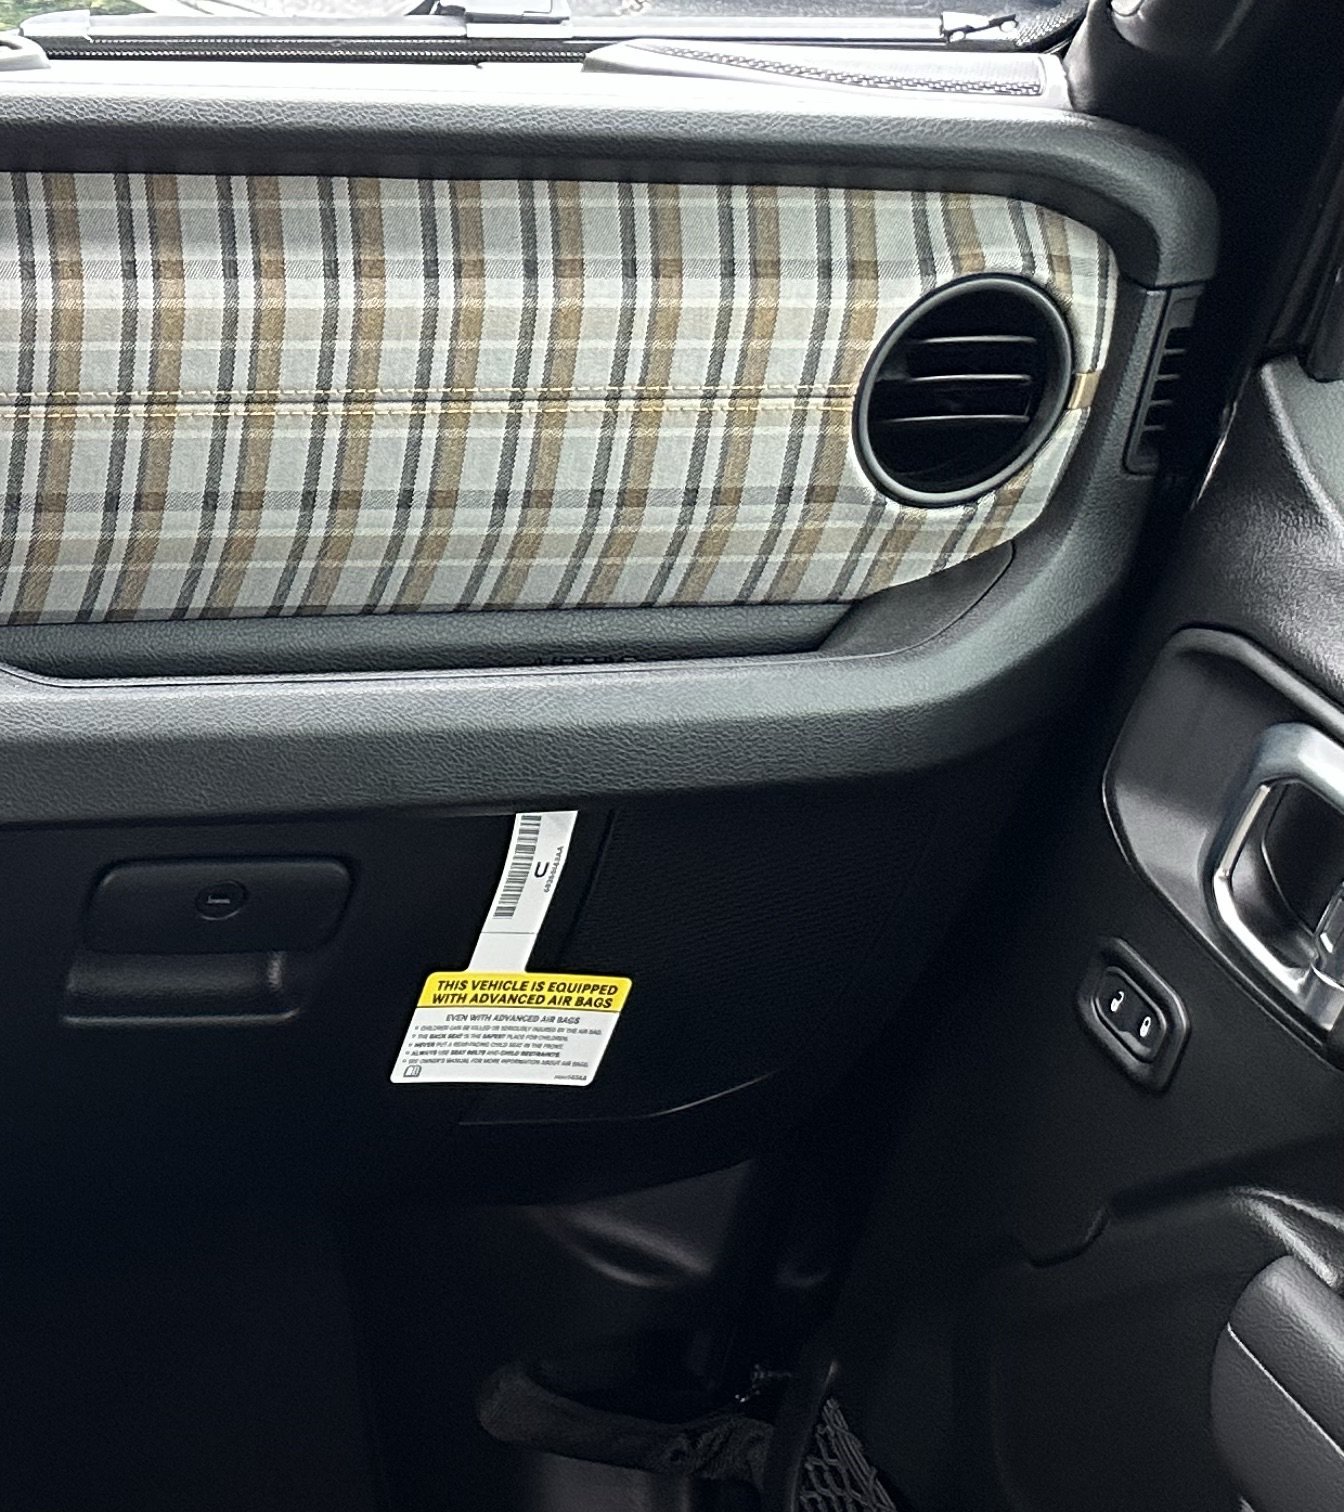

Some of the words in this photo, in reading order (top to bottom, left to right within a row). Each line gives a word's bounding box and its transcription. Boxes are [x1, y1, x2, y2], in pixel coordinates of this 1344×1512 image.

[438, 980, 468, 991] THIS
[471, 980, 529, 992] VEHICLE
[531, 982, 545, 992] IS
[548, 982, 618, 995] EQUIPPED
[432, 993, 467, 1004] WITH
[467, 994, 545, 1005] ADVANCED
[547, 995, 572, 1006] AIR
[575, 997, 613, 1008] BAGS
[493, 1014, 540, 1022] ADVANCED
[541, 1015, 555, 1023] AIR
[557, 1016, 580, 1024] BAGS
